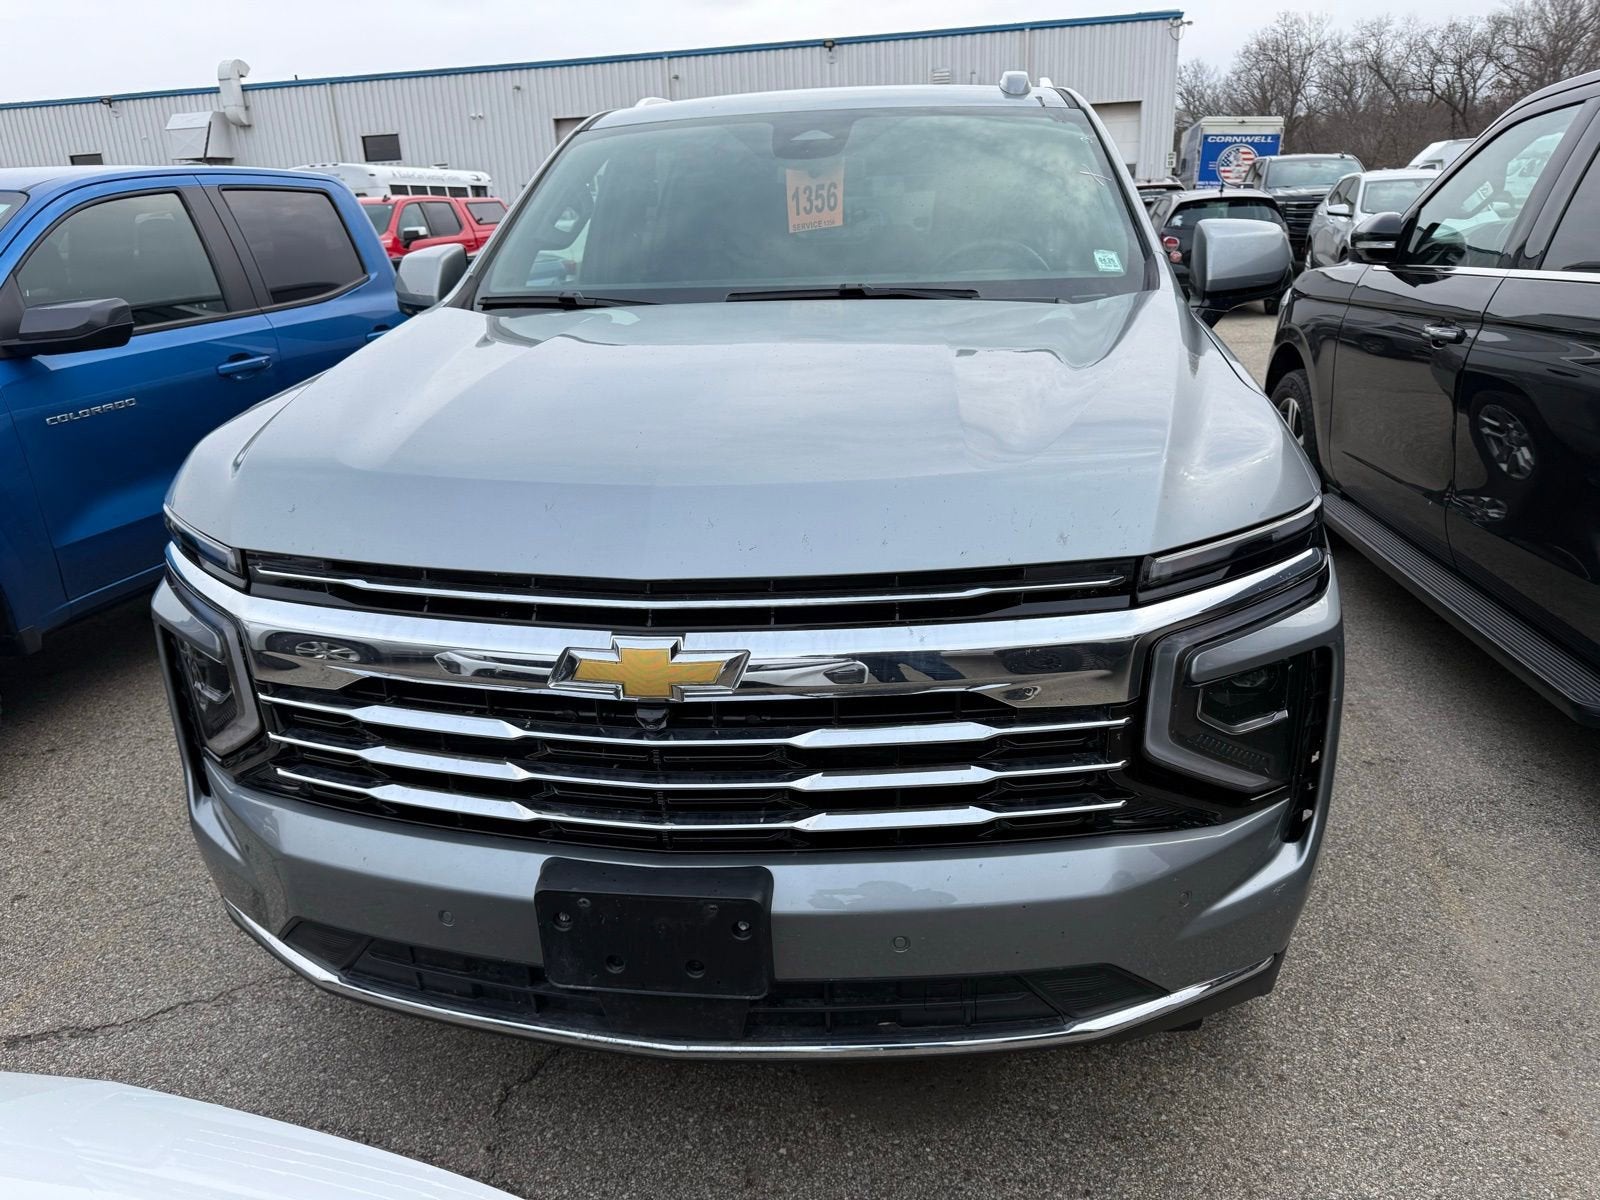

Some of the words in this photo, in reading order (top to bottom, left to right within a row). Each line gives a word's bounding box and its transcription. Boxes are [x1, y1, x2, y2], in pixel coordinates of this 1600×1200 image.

[791, 182, 838, 216] 1356
[792, 220, 822, 231] SERVICE
[46, 398, 136, 425] COLORADO
